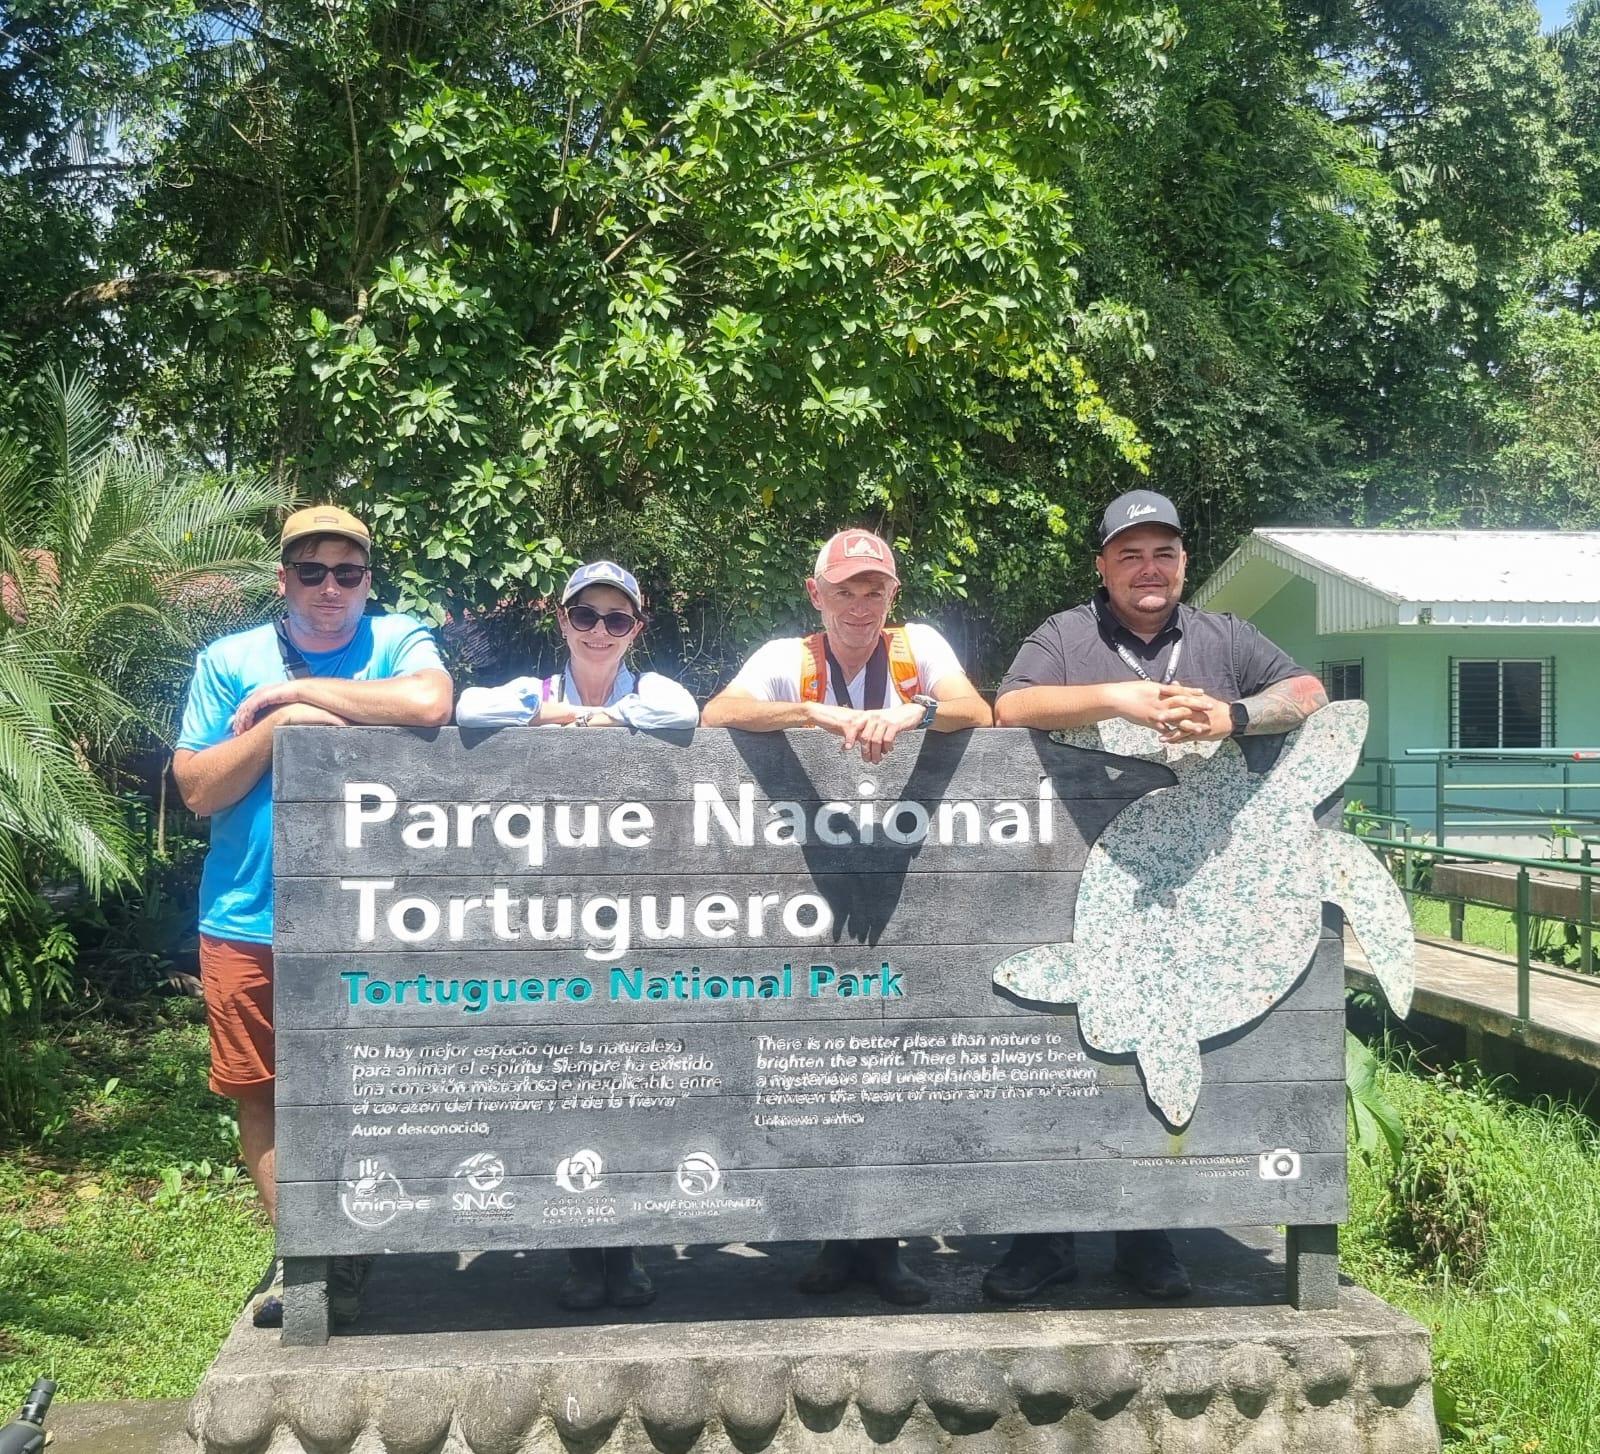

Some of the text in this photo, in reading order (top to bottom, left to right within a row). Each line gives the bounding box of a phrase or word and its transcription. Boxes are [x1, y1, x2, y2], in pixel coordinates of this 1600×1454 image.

[343, 776, 1053, 867] Parque Nacional
[340, 880, 834, 961] Tortuguero
[340, 962, 904, 1013] Tortuguero National Park
[384, 1043, 415, 1061] hay
[419, 1041, 469, 1060] mejor
[473, 1041, 538, 1060] espacio
[542, 1044, 573, 1059] que
[579, 1038, 594, 1055] la
[598, 1039, 683, 1055] naturaleza
[807, 1035, 821, 1050] is
[824, 1038, 845, 1050] no
[849, 1034, 901, 1050] better
[903, 1032, 947, 1051] place
[951, 1032, 986, 1047] than
[990, 1032, 1041, 1047] nature
[1046, 1032, 1062, 1045] to
[351, 1063, 391, 1082] para
[396, 1062, 455, 1077] animar
[459, 1058, 475, 1075] el
[552, 1057, 621, 1076] Siempre
[625, 1056, 645, 1071] ha
[649, 1053, 714, 1071] existido
[757, 1053, 824, 1073] brighten
[830, 1054, 857, 1067] the
[910, 1049, 956, 1065] There
[960, 1050, 987, 1064] has
[990, 1049, 1043, 1066] always
[1047, 1049, 1087, 1063] been
[353, 1083, 385, 1096] una
[577, 1072, 674, 1093] inexplicable
[679, 1075, 722, 1090] entre
[755, 1075, 767, 1088] a
[862, 1070, 892, 1085] and
[896, 1065, 1006, 1086] unexplainable
[547, 1099, 558, 1114] y
[928, 1090, 963, 1101] man
[351, 1123, 392, 1138] Autor
[452, 1191, 516, 1211] SINAC
[543, 1205, 616, 1217] COSTA RICA
[644, 1199, 677, 1213] CANJE
[701, 1198, 763, 1209] NATURALEZA
